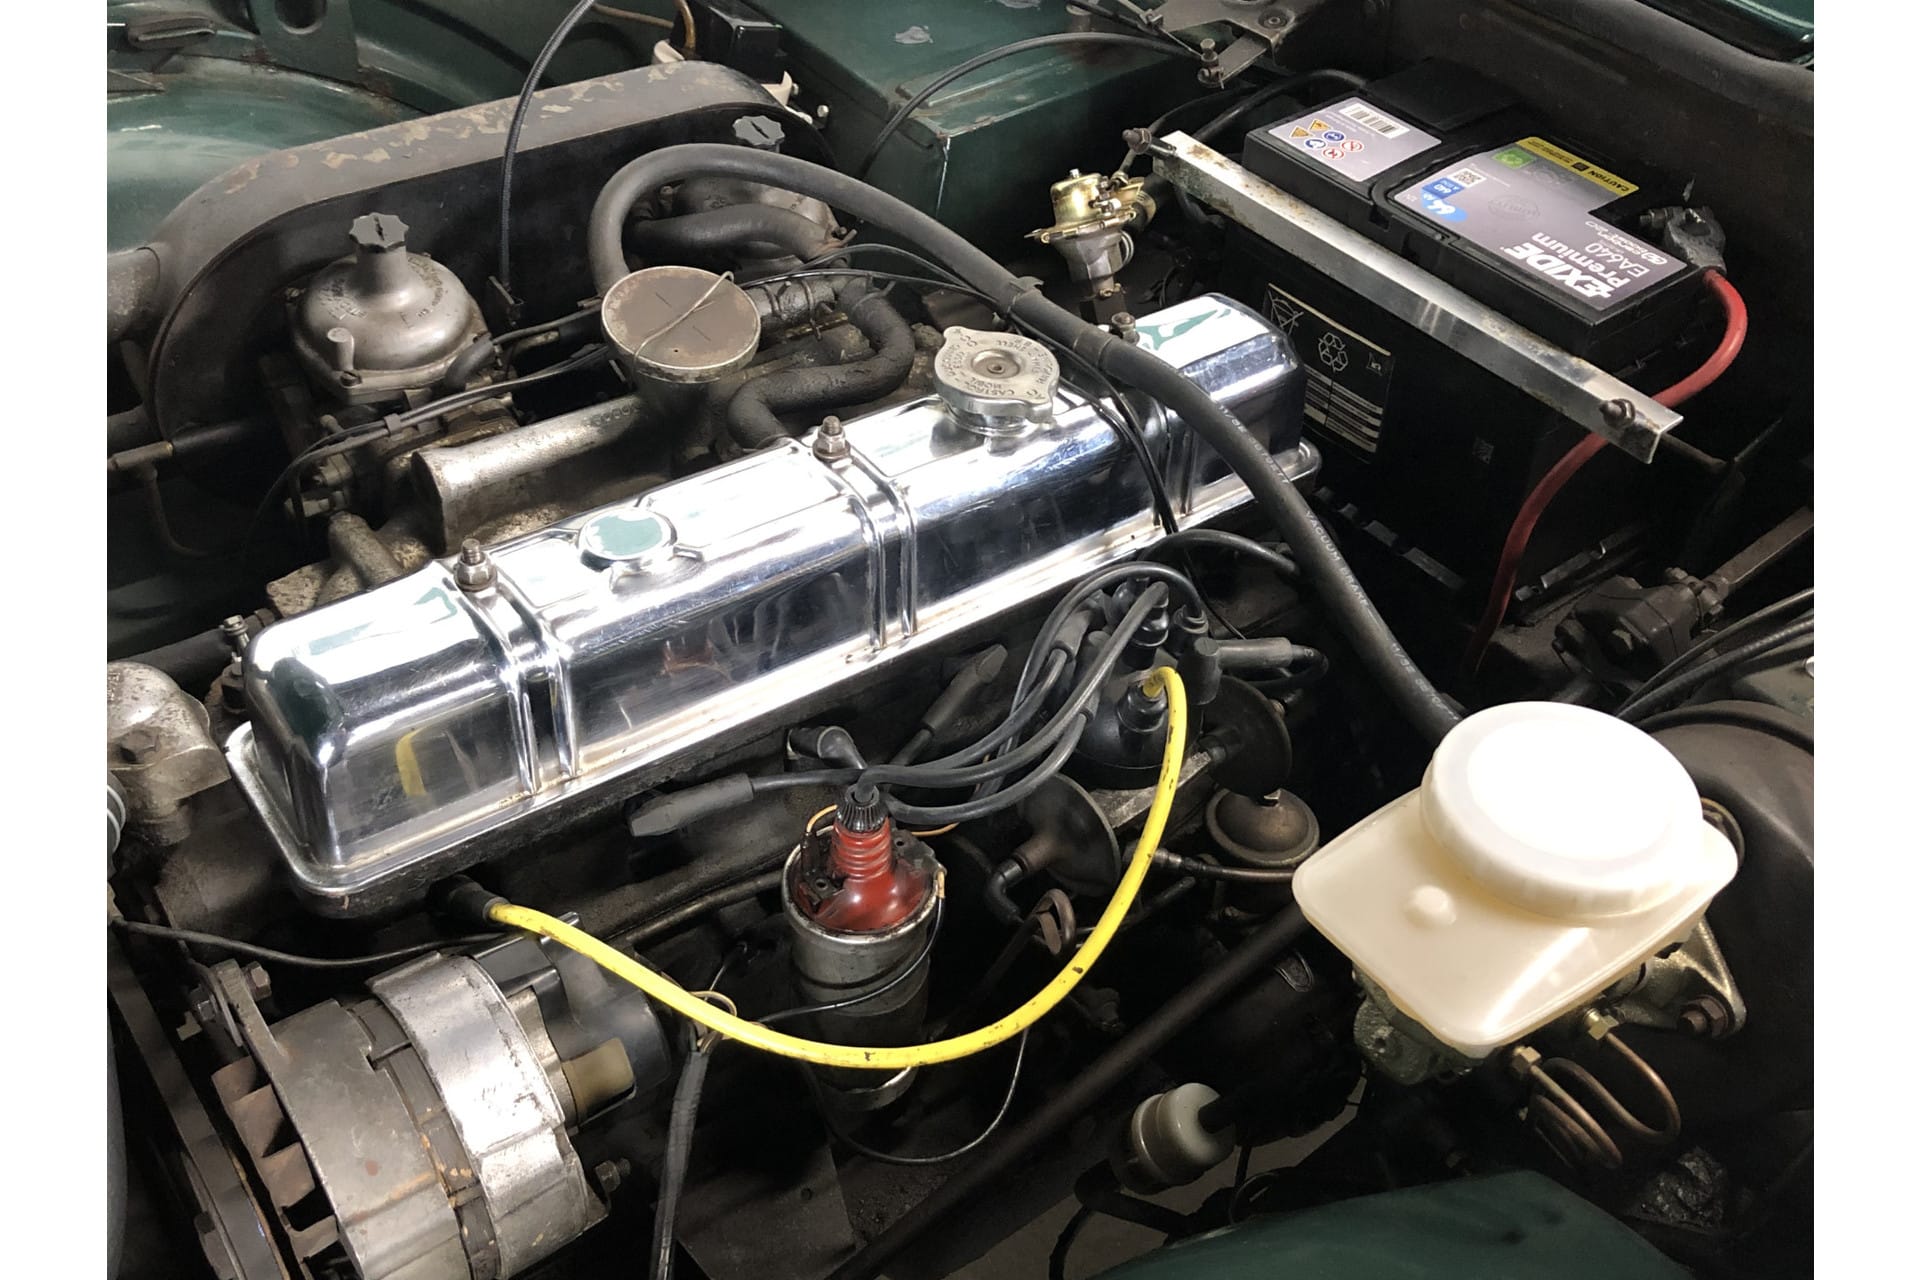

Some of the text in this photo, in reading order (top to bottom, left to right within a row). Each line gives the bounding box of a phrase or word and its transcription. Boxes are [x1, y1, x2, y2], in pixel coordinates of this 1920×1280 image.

[1588, 170, 1630, 192] CAUTION
[1503, 242, 1617, 298] EXIDE
[1531, 232, 1632, 288] Premium
[1585, 243, 1650, 278] EA640
[964, 381, 1015, 396] CASTROL
[1305, 510, 1341, 562] VACUUM
